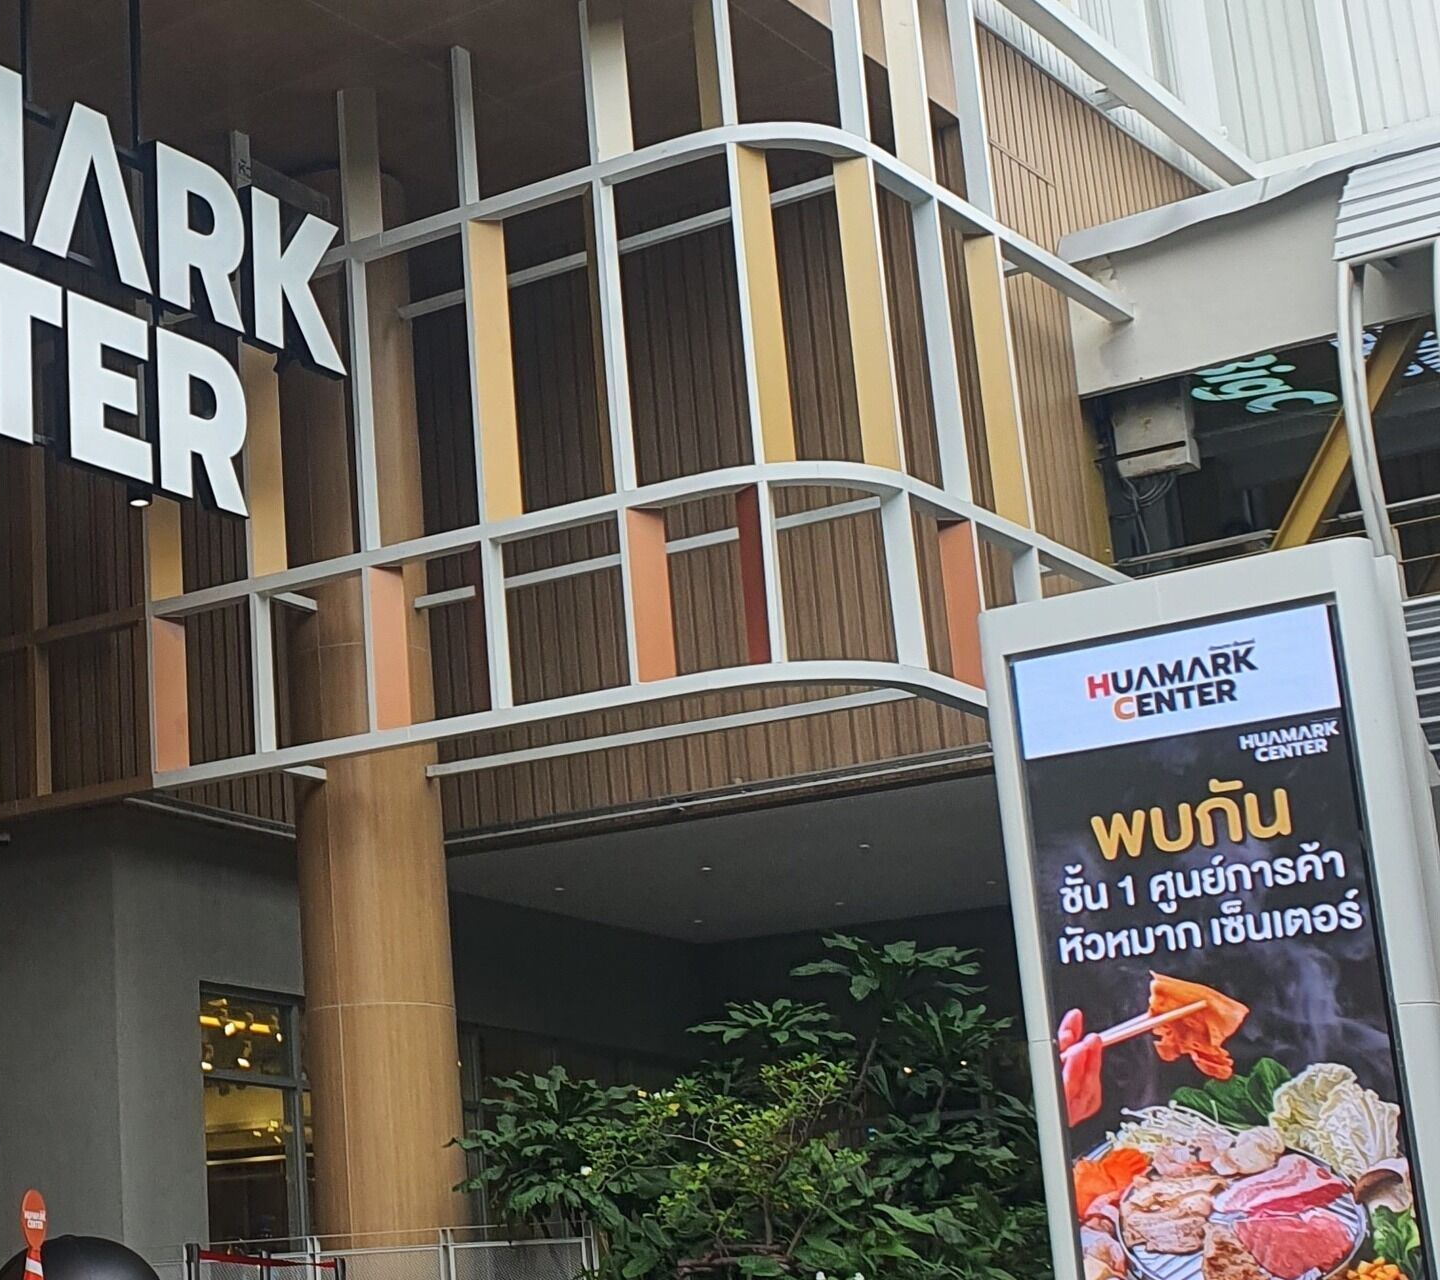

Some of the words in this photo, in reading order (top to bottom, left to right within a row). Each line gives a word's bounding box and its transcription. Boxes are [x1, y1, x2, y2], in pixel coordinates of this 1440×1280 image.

[1087, 646, 1258, 699] HUAMARK
[1113, 678, 1237, 720] CENTER
[1239, 721, 1341, 750] HUAMARK
[1254, 738, 1329, 762] CENTER
[1091, 778, 1293, 861] พบกัน
[1059, 864, 1109, 914] ชั้น
[1117, 875, 1136, 907] 1
[1149, 841, 1346, 914] ศูนย์การค้า
[1059, 920, 1203, 964] หัวหมาก
[1210, 888, 1364, 947] เซ็นเตอร์
